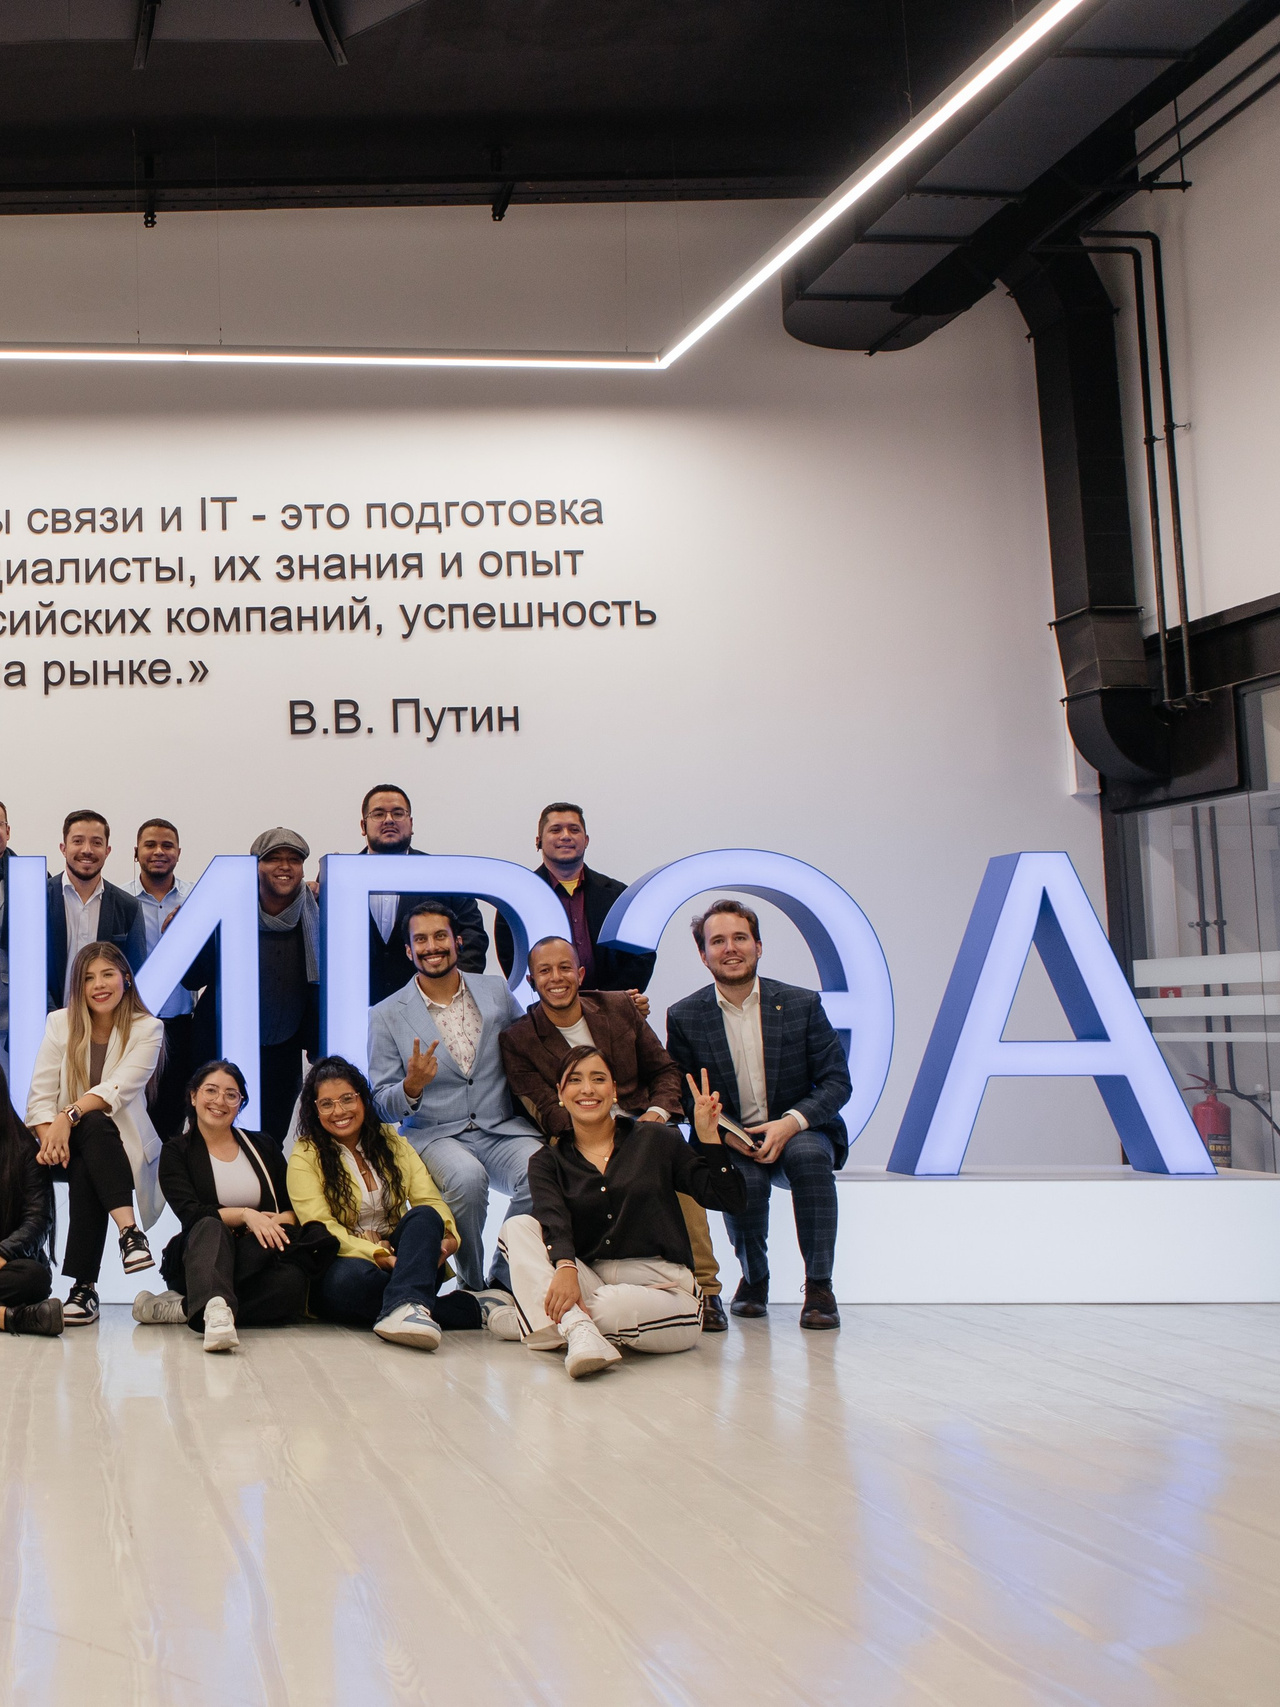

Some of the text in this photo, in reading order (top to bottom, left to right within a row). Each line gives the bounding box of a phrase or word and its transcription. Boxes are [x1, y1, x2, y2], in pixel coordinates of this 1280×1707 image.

[27, 507, 143, 535] связи
[160, 506, 182, 532] и
[200, 496, 238, 531] IT
[281, 503, 350, 530] это
[366, 498, 604, 534] подготовка
[214, 555, 262, 582] их
[275, 552, 424, 581] знания
[440, 552, 463, 578] и
[479, 549, 584, 578] опыт
[167, 595, 383, 637] компаний,
[398, 600, 657, 640] успешность
[43, 658, 209, 696] рынке.»
[289, 698, 520, 743] В.В. Путин
